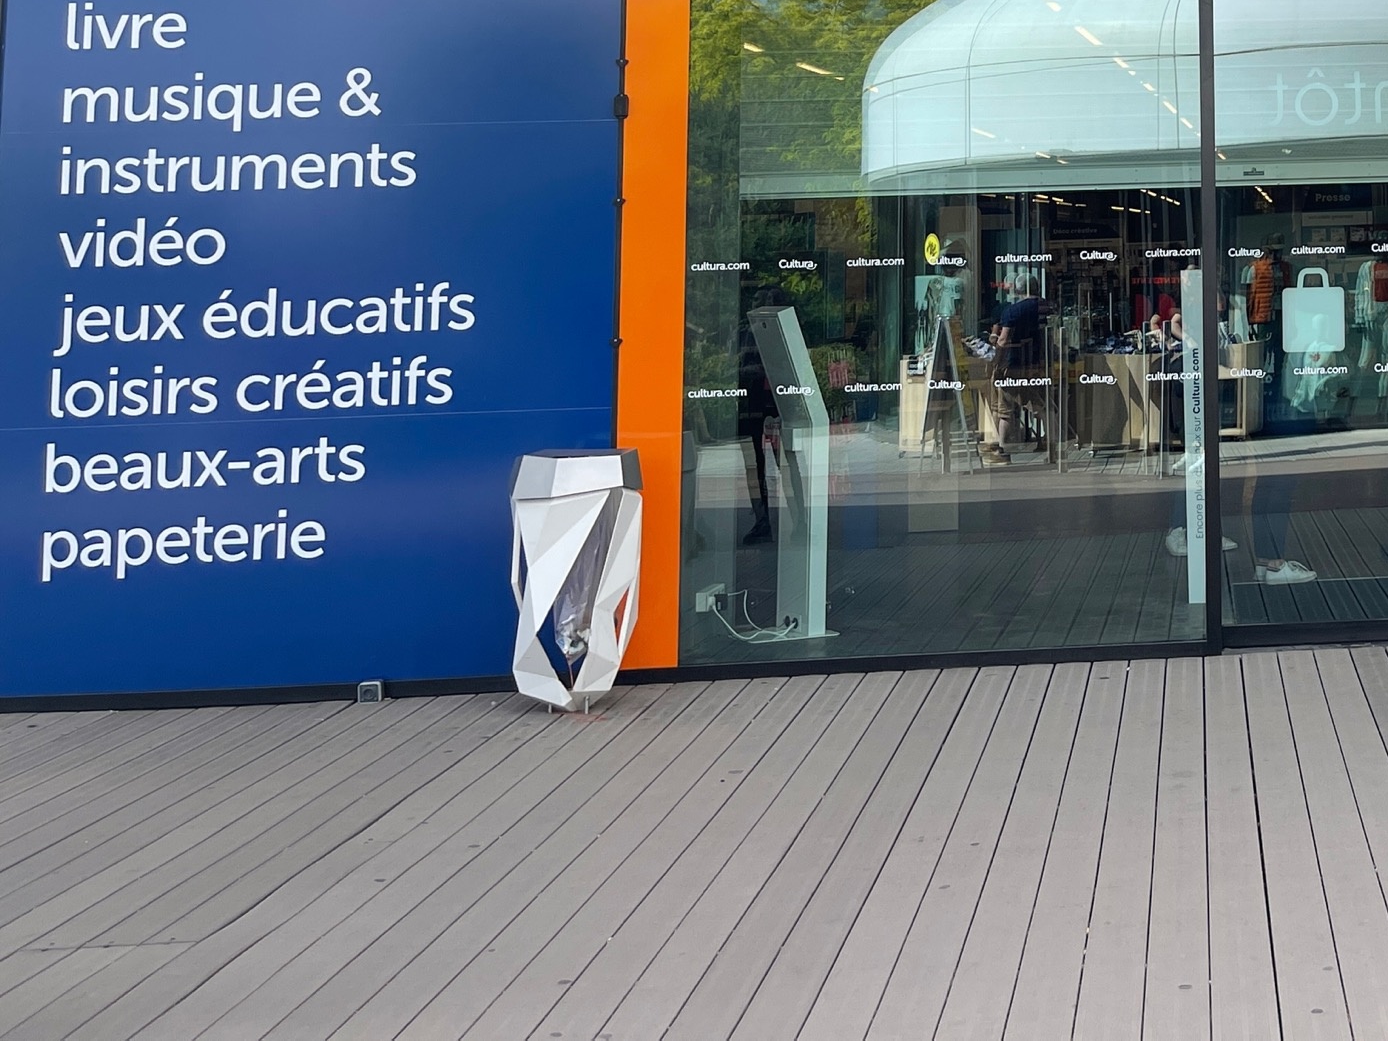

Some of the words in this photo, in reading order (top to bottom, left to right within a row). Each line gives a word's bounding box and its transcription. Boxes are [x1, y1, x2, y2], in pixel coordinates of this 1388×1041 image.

[65, 2, 187, 50] livre
[62, 72, 320, 132] musique
[339, 67, 381, 117] &
[59, 143, 417, 195] instruments
[59, 216, 226, 268] vidéo
[691, 260, 750, 272] cultura.com
[778, 259, 818, 271] Cultura
[846, 257, 905, 268] cultura.com
[995, 252, 1053, 263] cultura.com
[1079, 250, 1118, 262] Cultura
[1144, 247, 1201, 258] cultura.com
[1227, 247, 1264, 258] Cultura
[1291, 245, 1345, 255] cultura.com
[53, 294, 184, 357] jeux
[202, 282, 475, 339] éducatifs
[50, 365, 217, 418] loisirs
[236, 355, 453, 412] créatifs
[687, 387, 748, 399] cultura.com
[776, 384, 816, 397] Cultura
[844, 381, 903, 393] cultura.com
[927, 379, 966, 391] Cultura
[994, 376, 1052, 388] cultura.com
[1079, 374, 1118, 386] Cultura
[1145, 370, 1202, 382] cultura.com
[1230, 367, 1267, 379] Cultura
[1293, 365, 1348, 375] cultura.com
[44, 436, 366, 493] beaux-arts
[41, 509, 325, 581] papeterie
[1196, 503, 1205, 539] Encore
